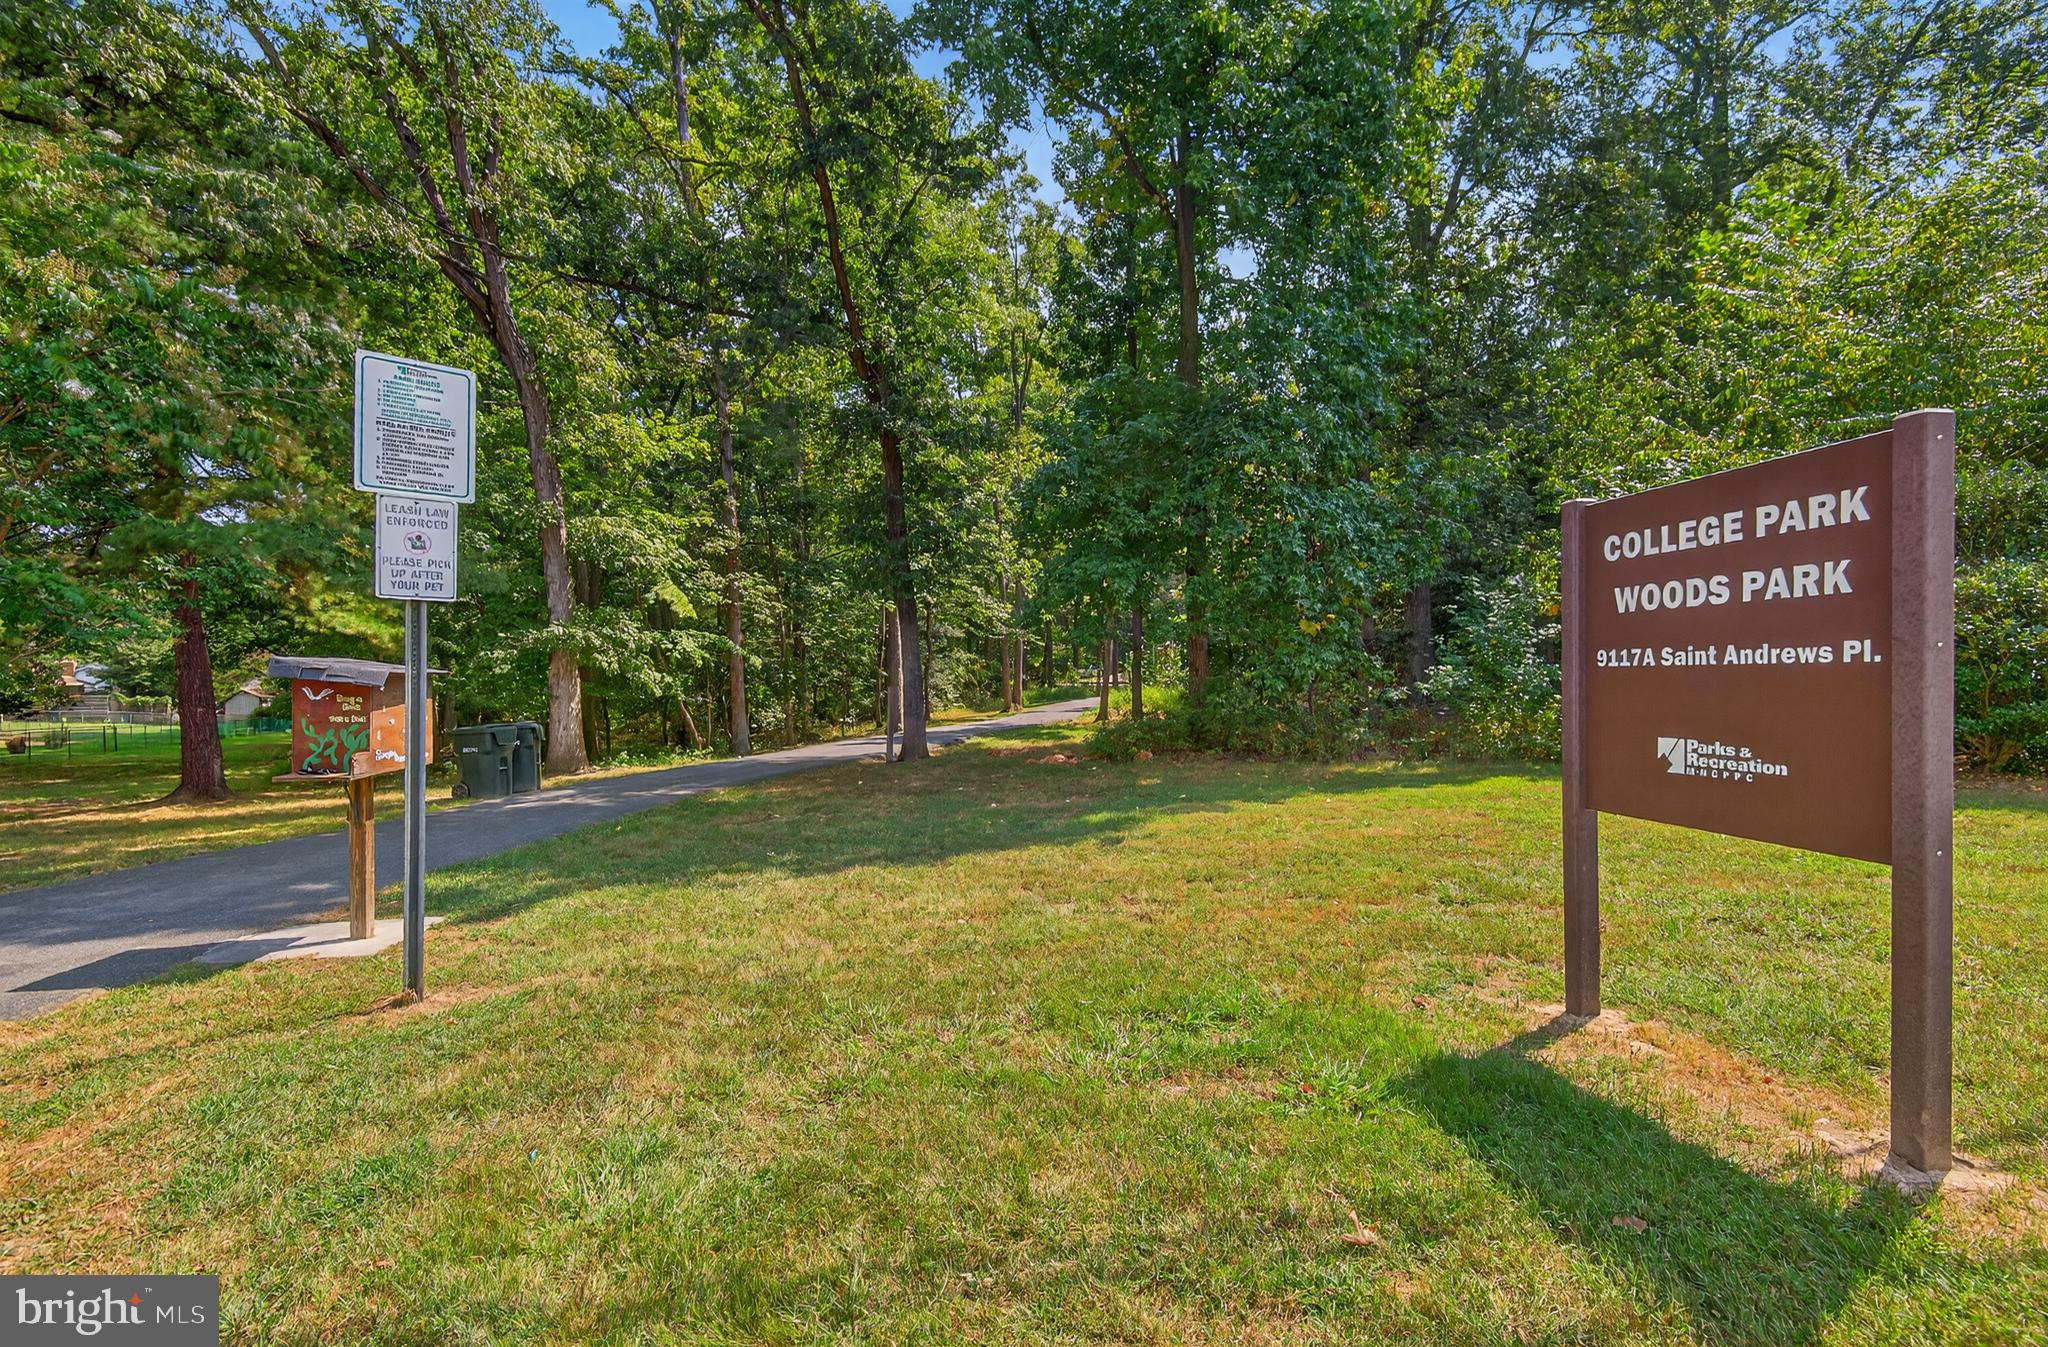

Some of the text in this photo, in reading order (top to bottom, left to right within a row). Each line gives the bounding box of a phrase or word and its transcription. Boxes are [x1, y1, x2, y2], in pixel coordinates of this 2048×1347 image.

[385, 503, 449, 519] LEASH LAW
[386, 516, 448, 530] ENFORCED
[1603, 486, 1871, 562] COLLEGE PARK
[382, 556, 452, 569] PLEASE PICK
[391, 569, 443, 581] UP AFTER
[390, 580, 444, 592] YOUR PET
[1614, 559, 1853, 614] WOODS PARK
[1597, 639, 1882, 667] 9117A Saint Andrews Pl.
[1686, 739, 1753, 758] Parks &
[1686, 752, 1788, 776] Recreation
